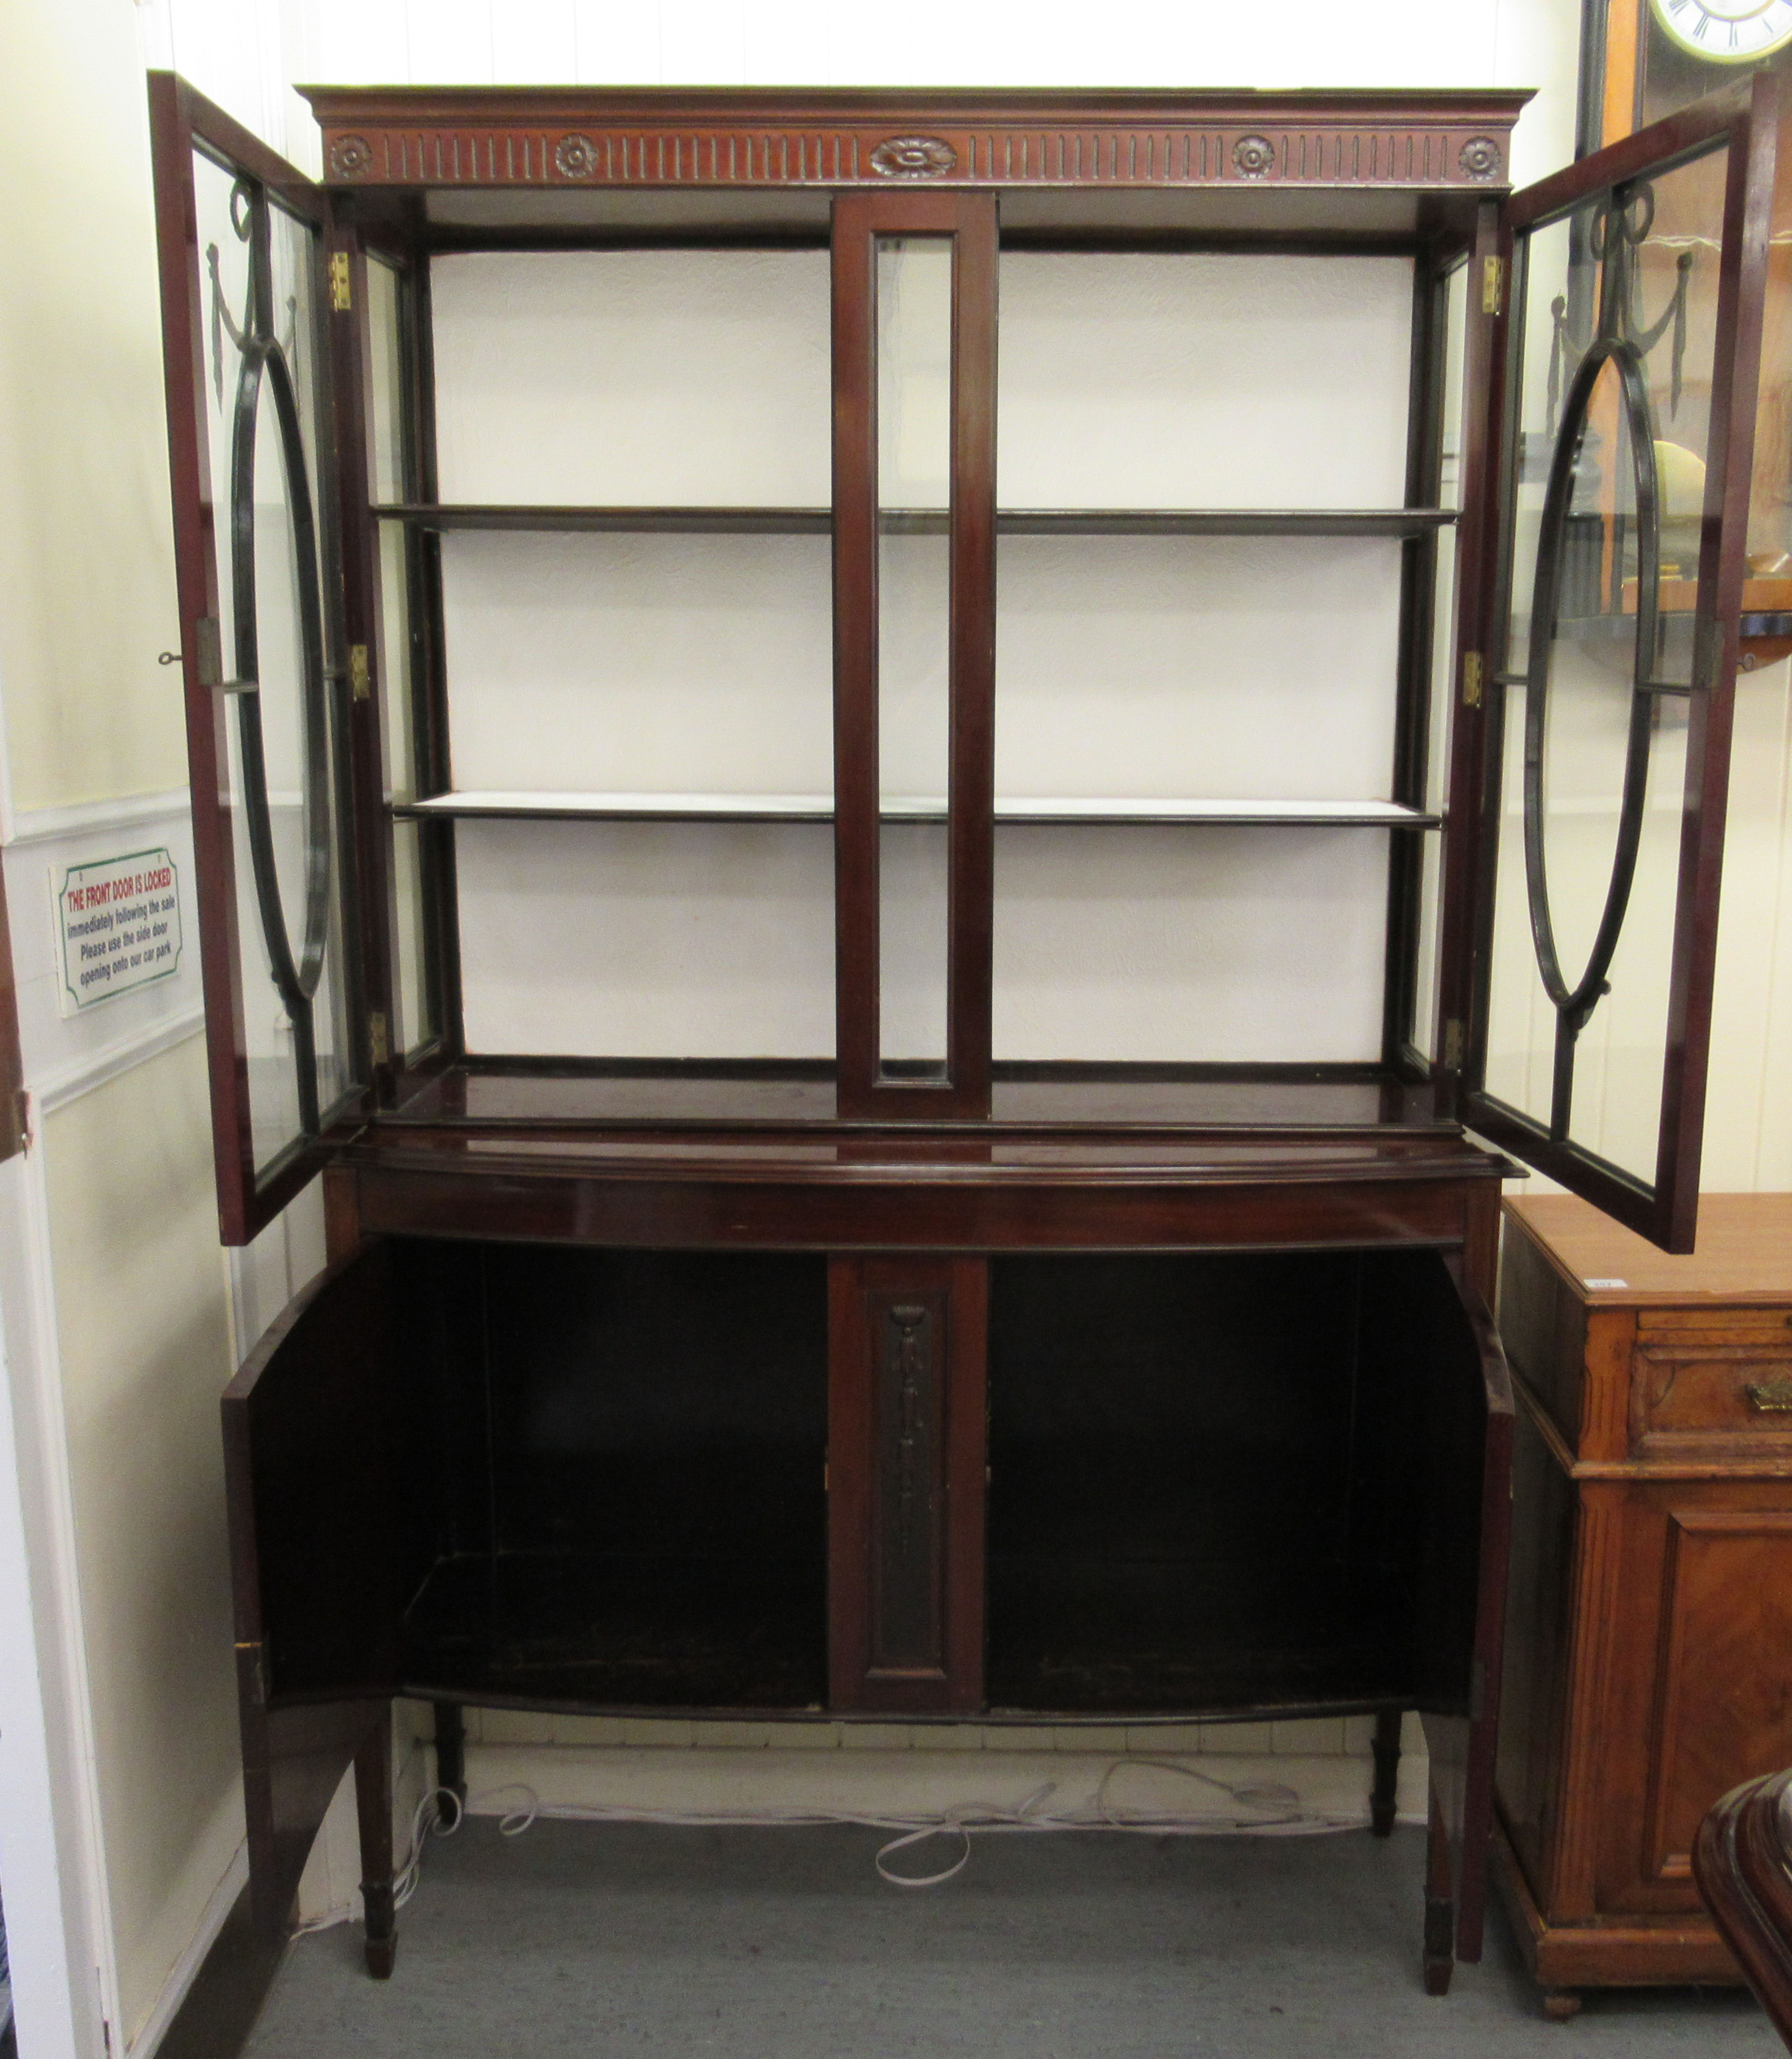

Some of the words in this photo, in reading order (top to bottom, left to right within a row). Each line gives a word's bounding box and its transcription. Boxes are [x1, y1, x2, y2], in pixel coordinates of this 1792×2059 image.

[68, 888, 85, 912] THE
[86, 882, 111, 908] FRONT
[113, 877, 133, 900] DOOR
[135, 874, 142, 894] IS
[145, 868, 171, 892] LOCKED
[68, 911, 113, 939] immediately
[116, 902, 147, 925] following
[149, 899, 160, 914] the
[161, 895, 175, 911] sale
[81, 942, 106, 961] Please
[109, 937, 121, 952] use
[123, 930, 134, 946] the
[136, 924, 151, 942] side
[153, 922, 167, 936] door
[80, 963, 111, 988] opening
[113, 956, 129, 974] onto
[130, 953, 142, 967] our
[143, 949, 154, 962] car
[157, 940, 171, 962] park
